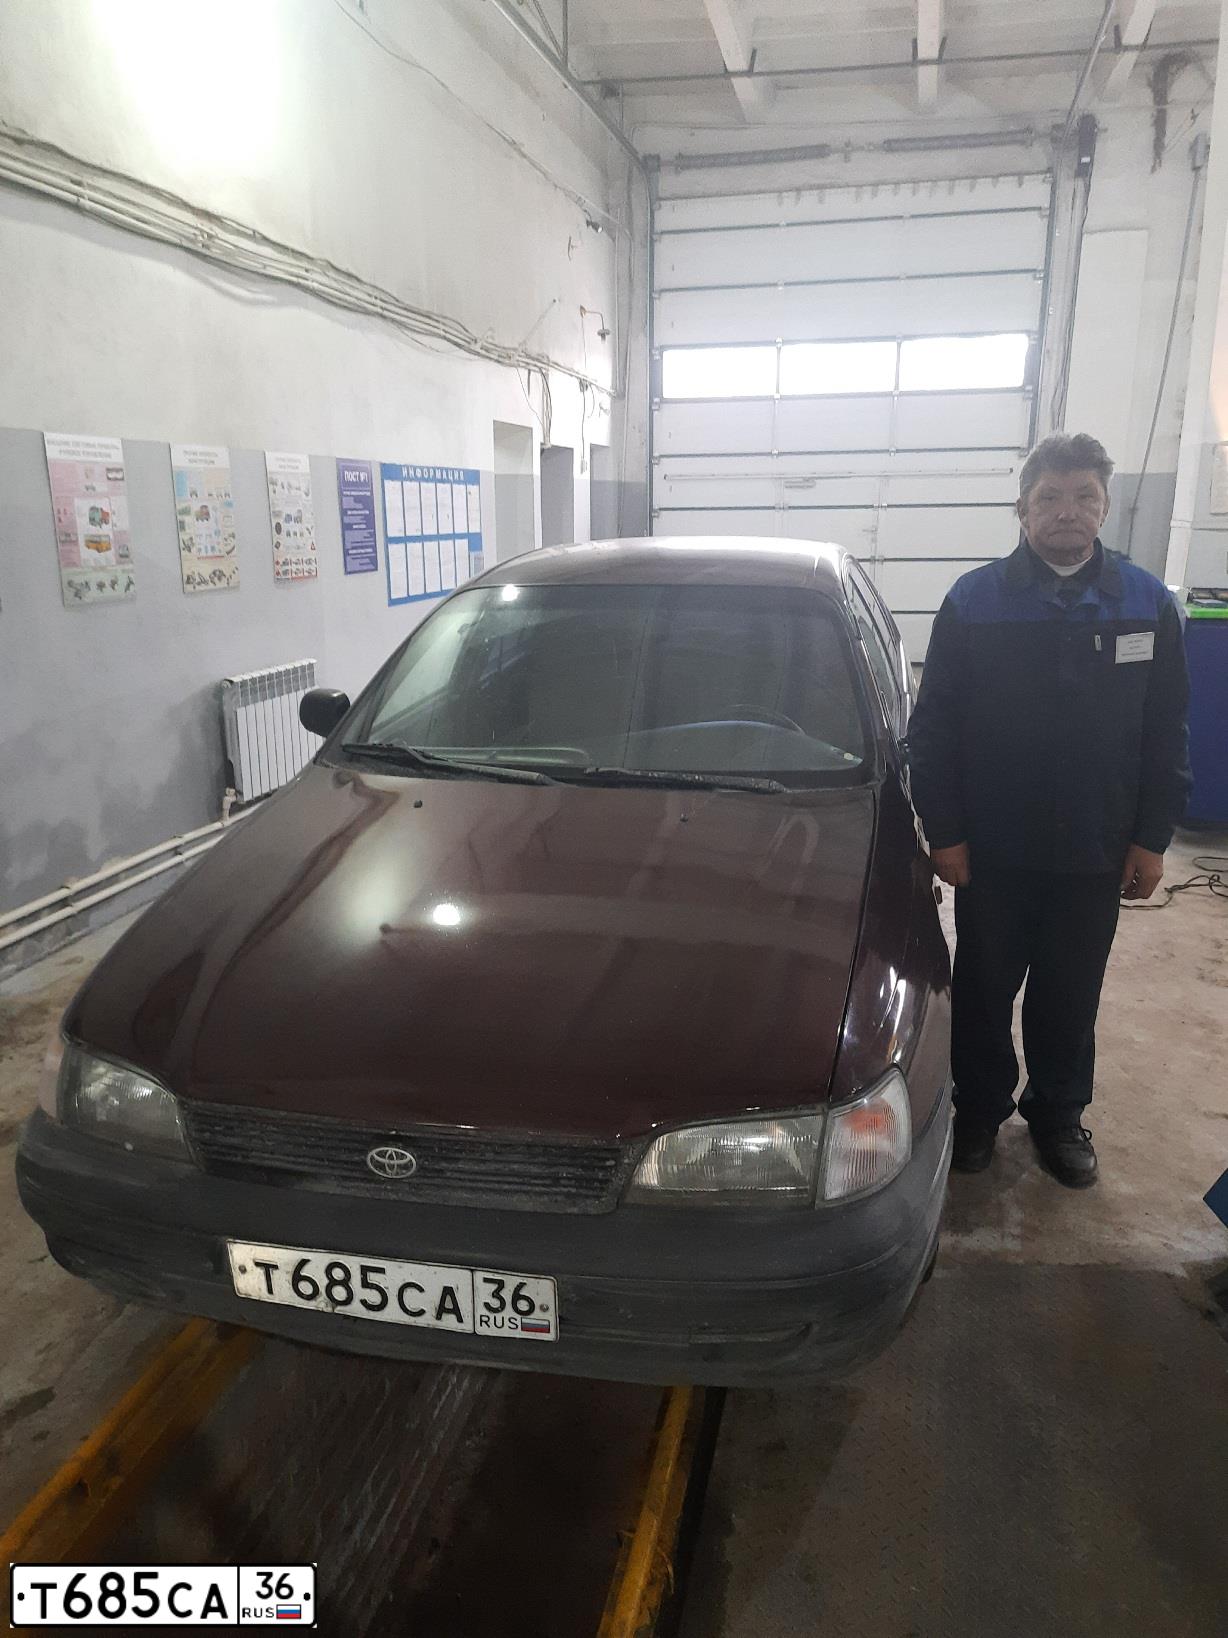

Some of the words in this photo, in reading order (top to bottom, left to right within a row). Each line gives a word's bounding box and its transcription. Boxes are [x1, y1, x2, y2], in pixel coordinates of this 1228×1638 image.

[344, 470, 360, 483] ПОСТ
[402, 467, 465, 482] ИНФОРМАЦИЯ
[254, 1258, 464, 1323] Т685СА
[482, 1277, 535, 1316] 36
[479, 1315, 519, 1330] RUS
